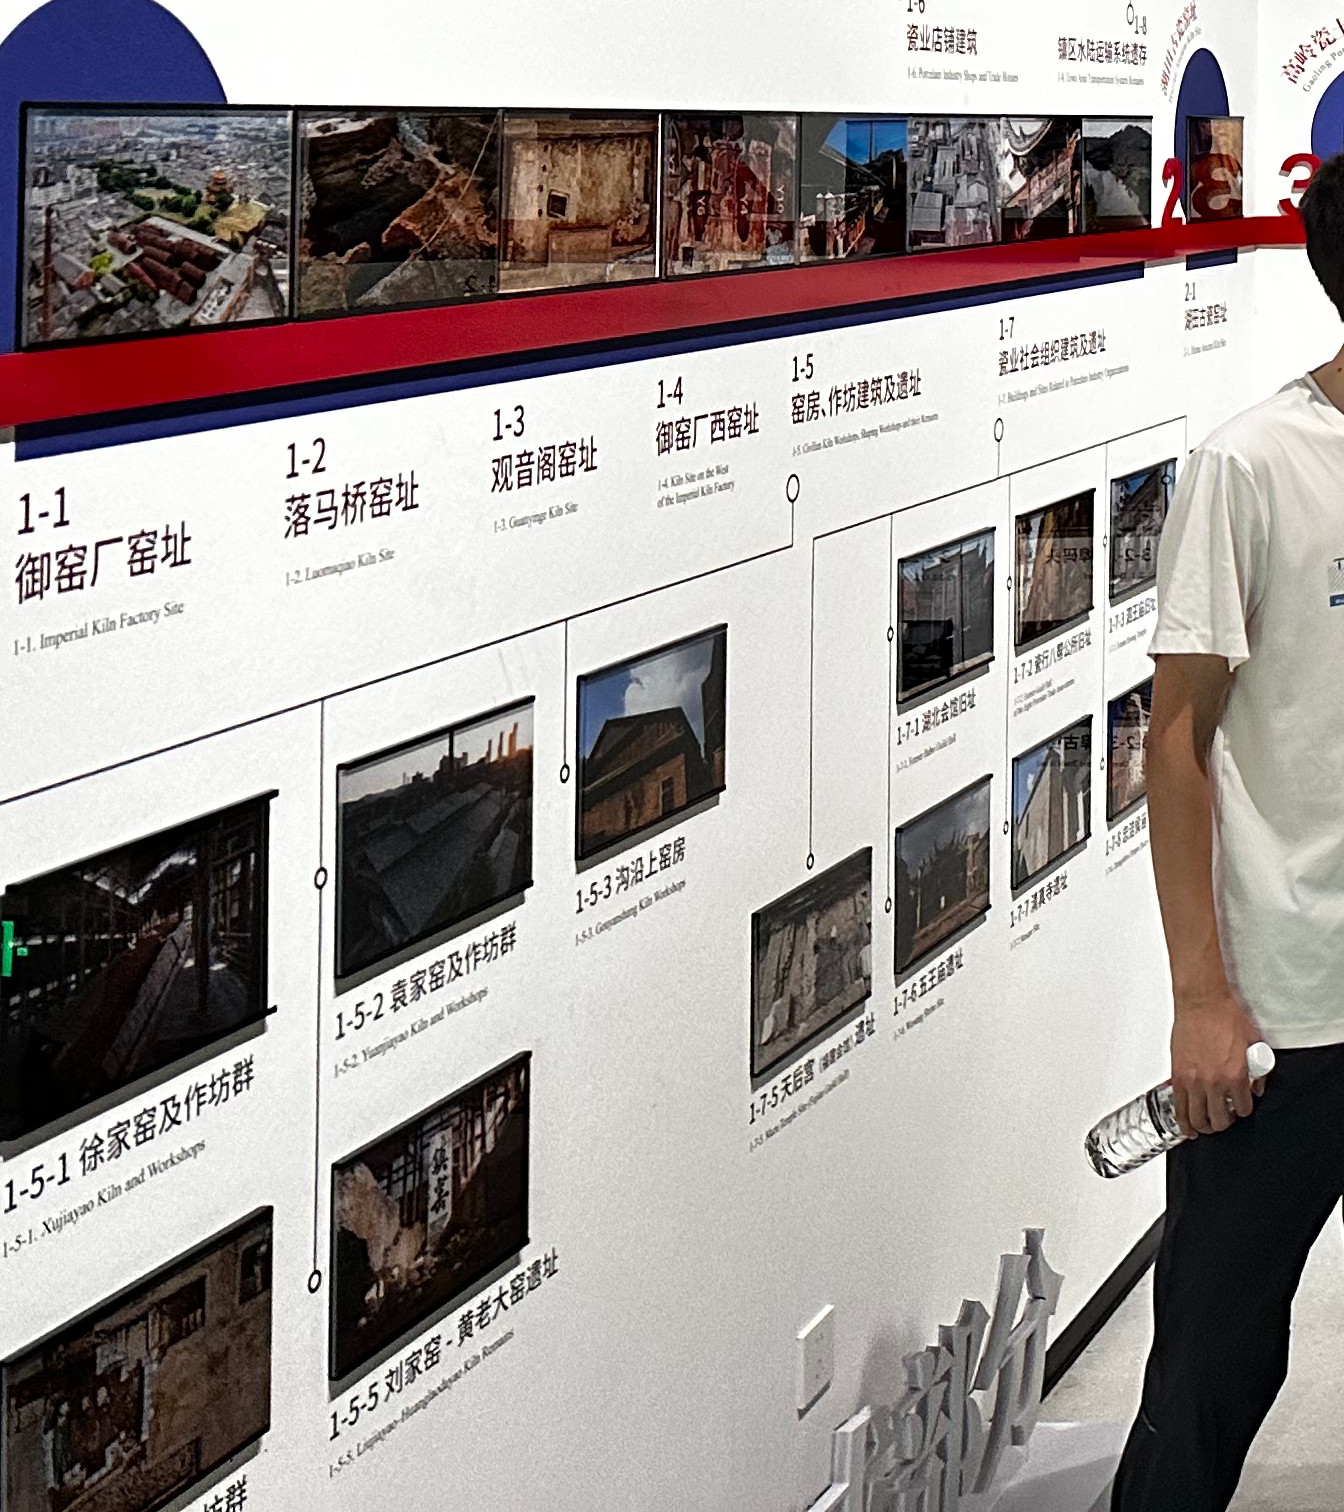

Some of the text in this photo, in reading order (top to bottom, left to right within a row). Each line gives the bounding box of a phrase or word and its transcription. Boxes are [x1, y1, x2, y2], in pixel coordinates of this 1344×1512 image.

[907, 23, 978, 55] 瓷业店铺建筑
[1135, 15, 1147, 35] 1-8
[1162, 158, 1183, 227] 2
[1185, 282, 1195, 301] 2-1
[999, 316, 1014, 340] 1-7
[657, 376, 683, 408] 1-4
[792, 353, 813, 382] 1-5
[791, 368, 921, 424] 窑房、作坊建筑及遗址
[492, 404, 525, 441] 1-3
[656, 401, 759, 456] 御窑厂西窑址
[286, 438, 326, 479] 1-2
[491, 435, 598, 493] 观音阁窑址
[17, 486, 70, 536] 1-1
[284, 470, 419, 539] 落马桥窑址
[14, 521, 192, 604] 御窑厂窑址
[13, 599, 185, 657] 1-1. Imperial Kiln Factory Site
[897, 718, 919, 746] 1-7-1
[576, 836, 686, 915] 1-5-3 沟沿上窑房
[335, 920, 517, 1041] 1-5-2 袁家窑及作坊群
[893, 983, 916, 1016] 1-7-6
[749, 1085, 778, 1125] 1-7-5
[3, 1054, 256, 1215] 1-5-1 徐家窑及作坊群
[42, 1139, 206, 1238] Xujiayao Kiln and Workshops
[329, 1382, 379, 1442] 1-5-5
[383, 1334, 442, 1405] 刘家窑
[456, 1246, 560, 1348] 黄老大窑遗址
